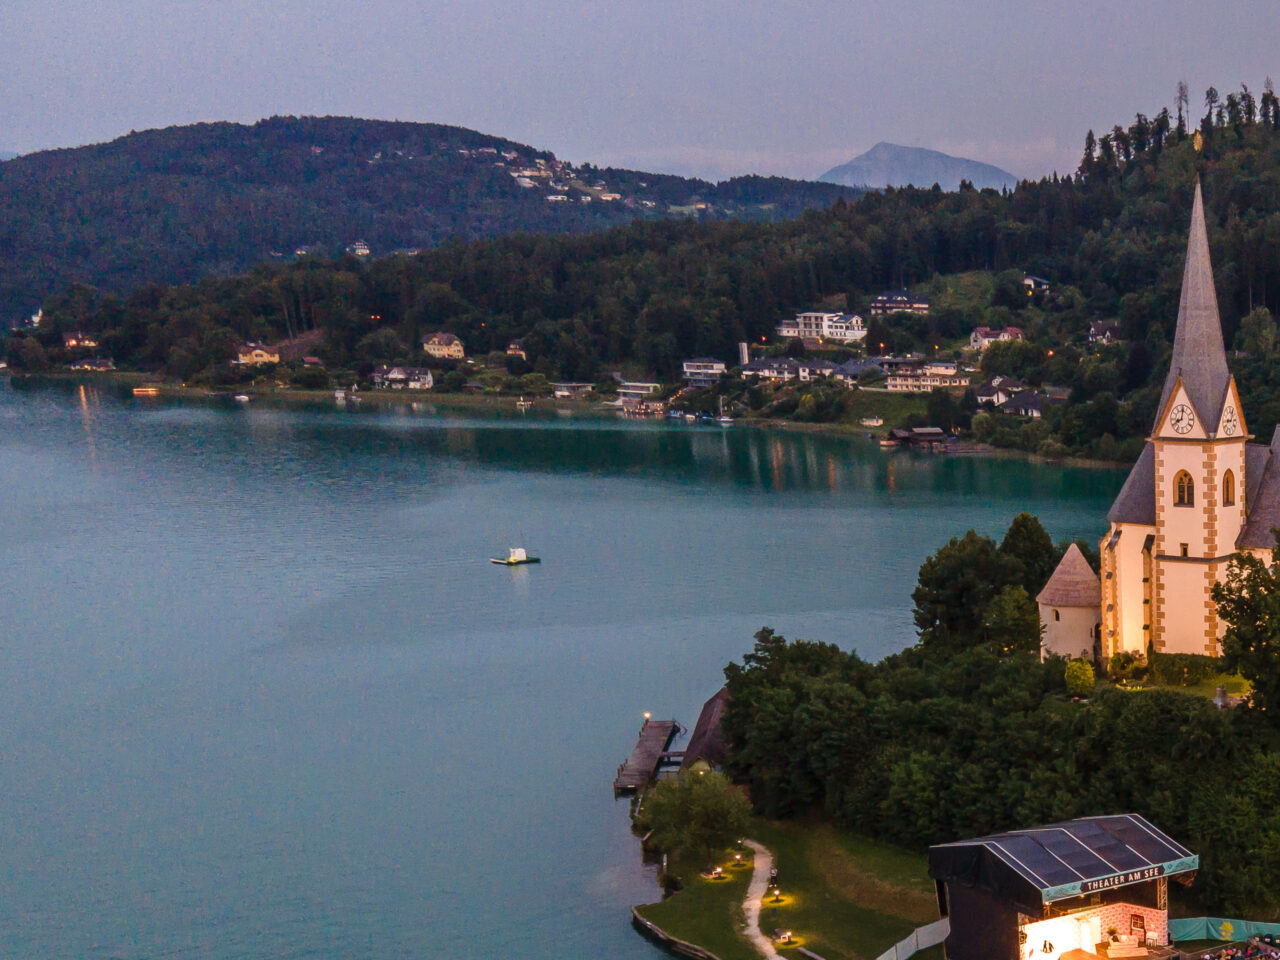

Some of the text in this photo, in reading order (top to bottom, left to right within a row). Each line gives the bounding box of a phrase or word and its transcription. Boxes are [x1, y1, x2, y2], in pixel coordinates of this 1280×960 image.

[1087, 867, 1159, 891] THEATER AM SEE
